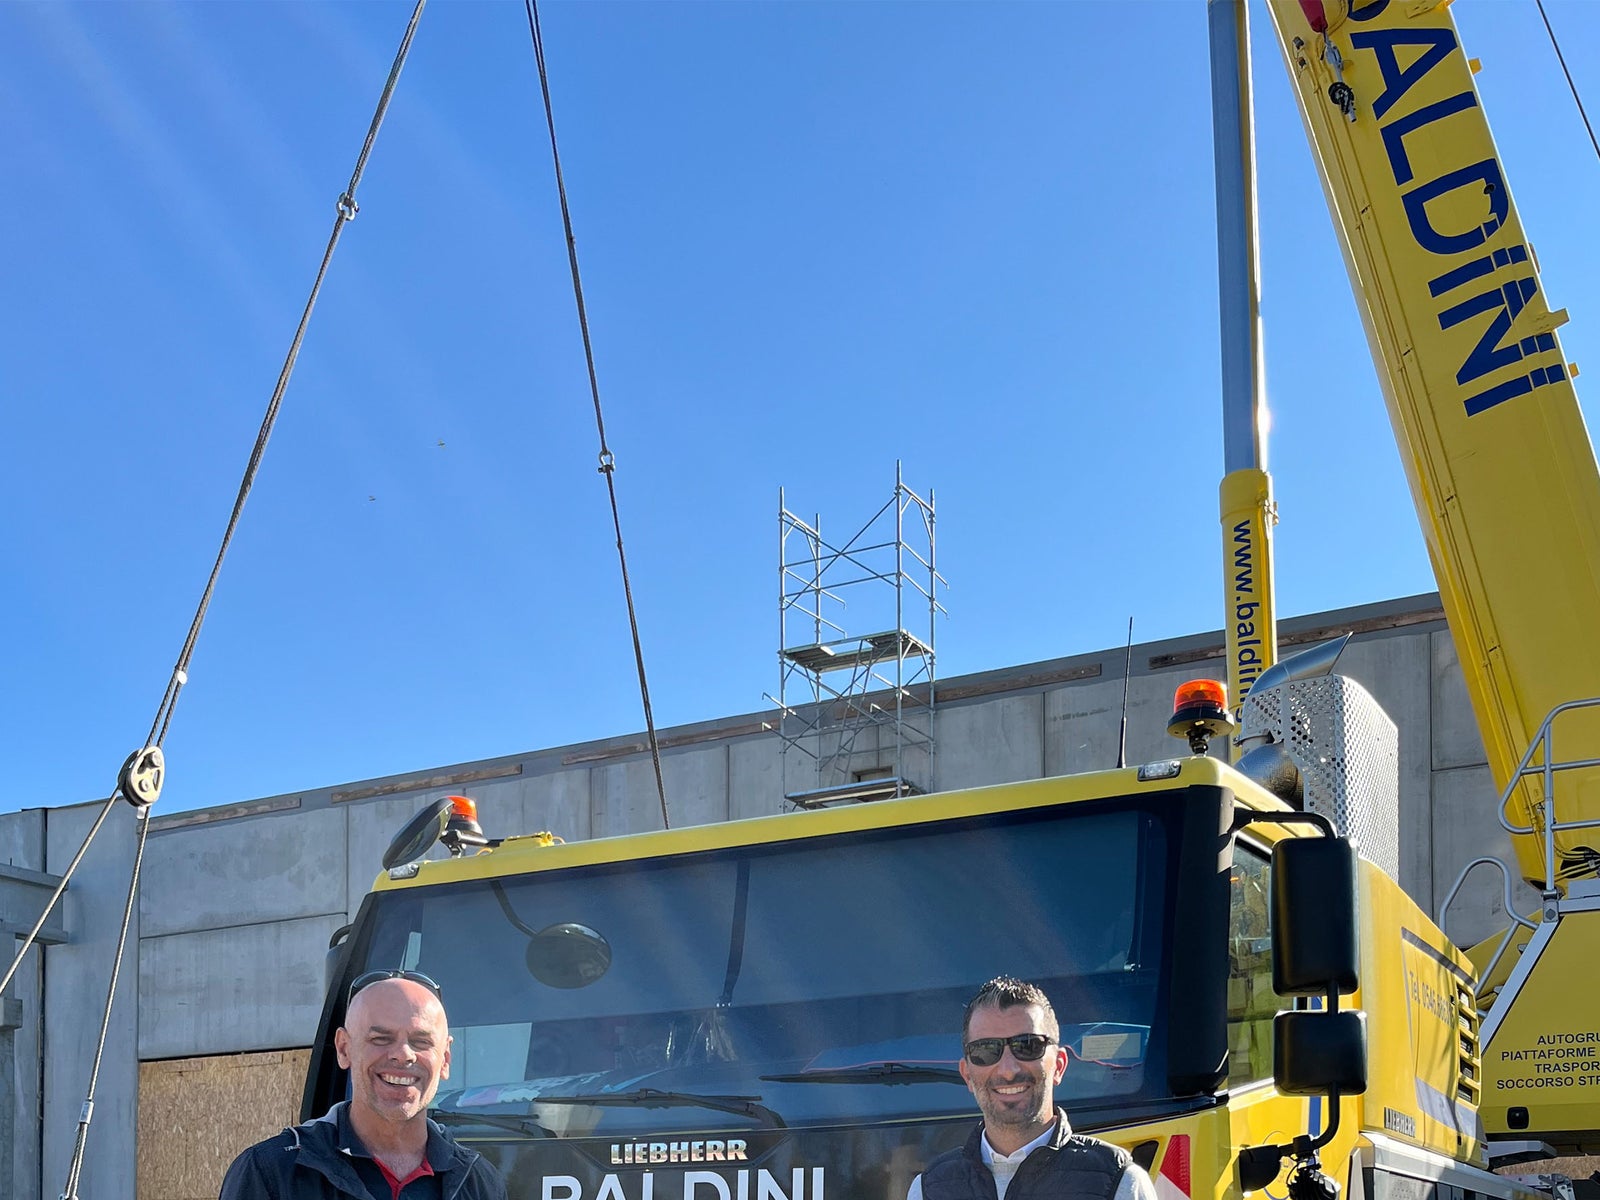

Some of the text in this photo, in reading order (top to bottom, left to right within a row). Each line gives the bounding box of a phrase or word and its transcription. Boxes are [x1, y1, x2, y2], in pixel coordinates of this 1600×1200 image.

[1501, 1047, 1596, 1061] PIATTAFORME
[1534, 1061, 1600, 1073] TRASPOR
[1497, 1076, 1574, 1090] SOCCORSO
[611, 1139, 749, 1164] LIEBHERR
